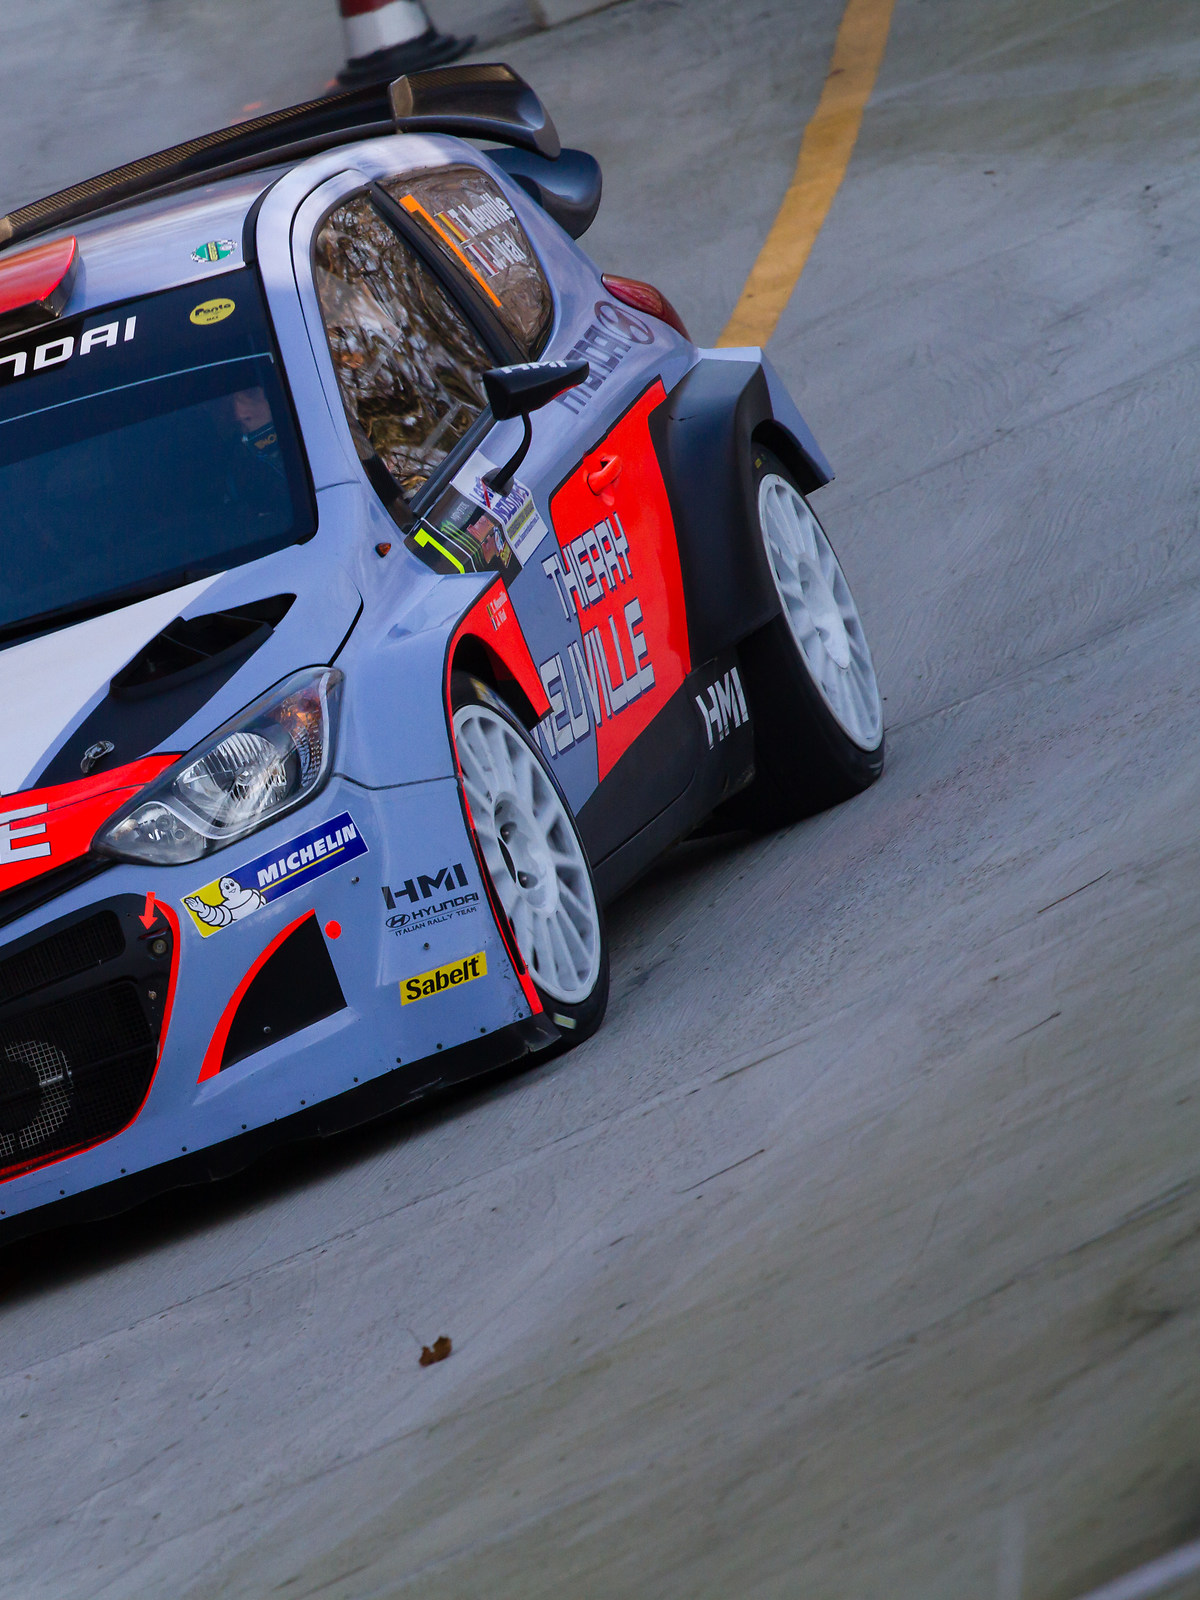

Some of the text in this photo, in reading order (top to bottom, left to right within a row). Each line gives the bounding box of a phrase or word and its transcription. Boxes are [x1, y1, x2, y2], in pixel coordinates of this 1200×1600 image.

[541, 511, 633, 622] THIERRY
[695, 666, 750, 750] HMI
[257, 823, 357, 887] MICHELIN
[381, 863, 468, 910] HMI
[412, 892, 479, 919] HYUNDAI
[395, 906, 477, 937] ITALIAN RALLY TEAM
[406, 955, 481, 1002] Sabelt
